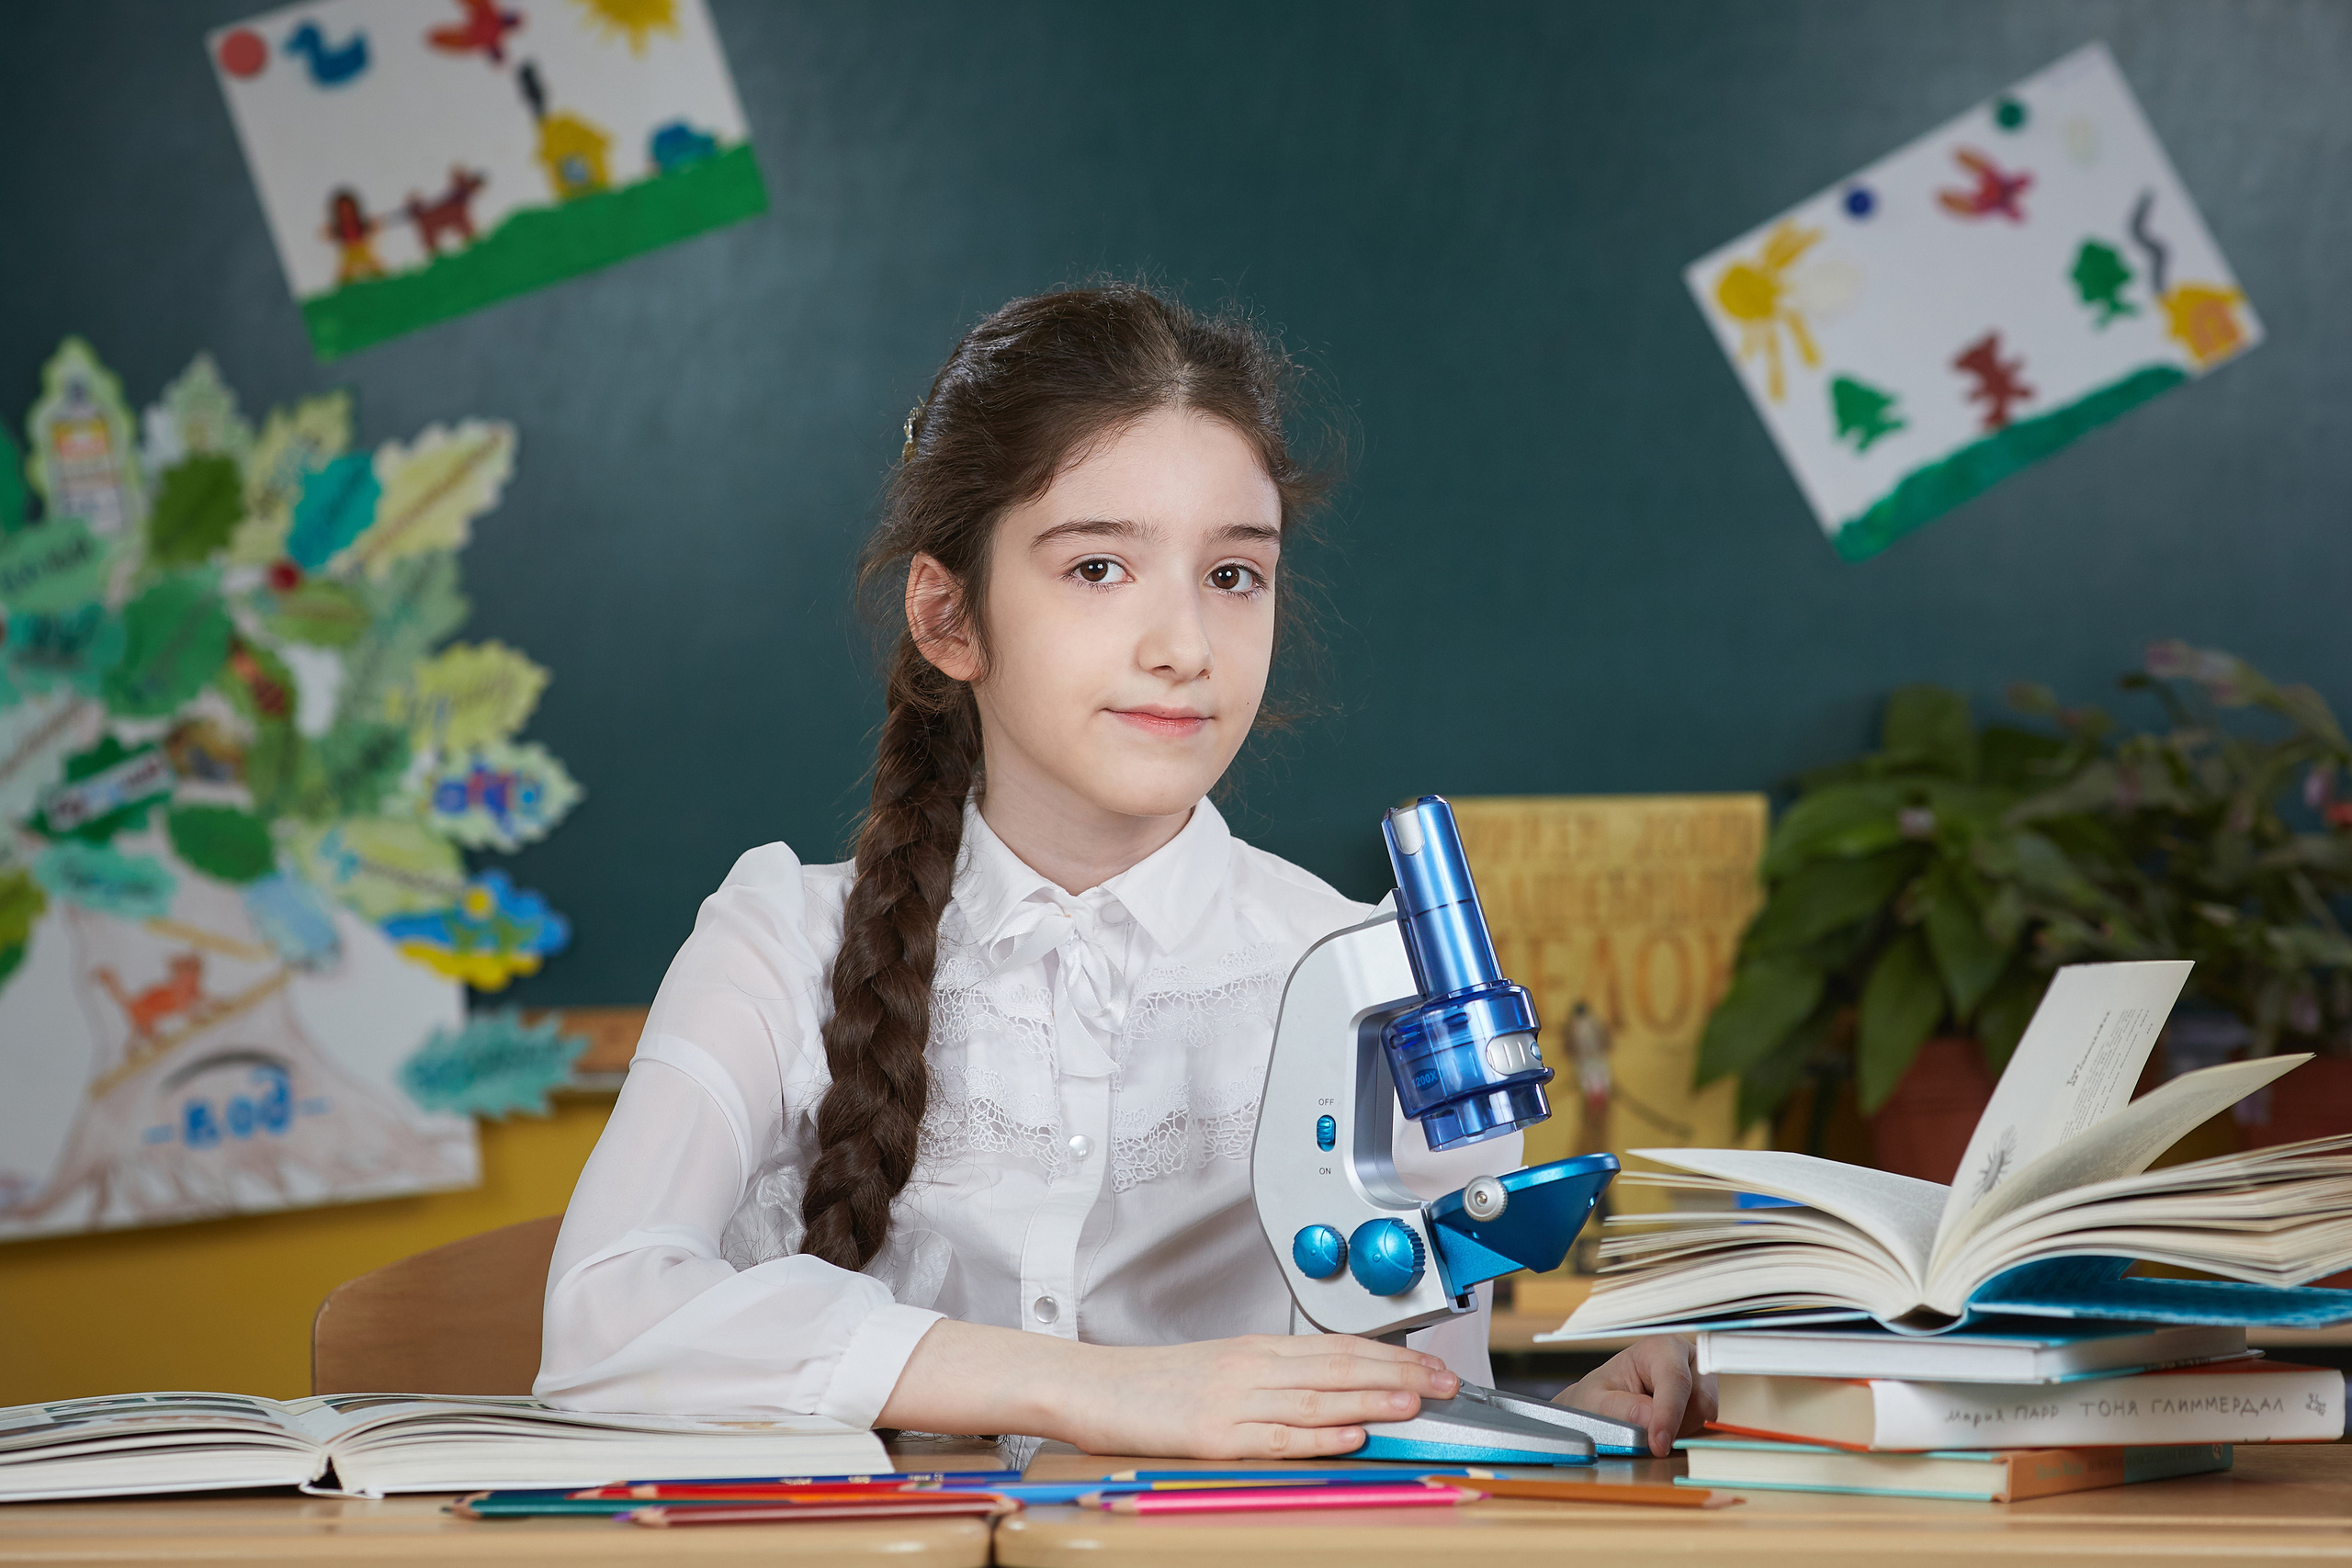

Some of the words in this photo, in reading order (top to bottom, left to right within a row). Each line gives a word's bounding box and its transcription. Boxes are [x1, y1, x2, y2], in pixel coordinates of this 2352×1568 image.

[1317, 1098, 1335, 1106] OFF
[1318, 1166, 1331, 1176] ON
[2014, 1404, 2060, 1422] ПАРР
[2079, 1398, 2139, 1417] ТОНЯ
[2151, 1395, 2285, 1417] ГЛИММЕРДАЛ
